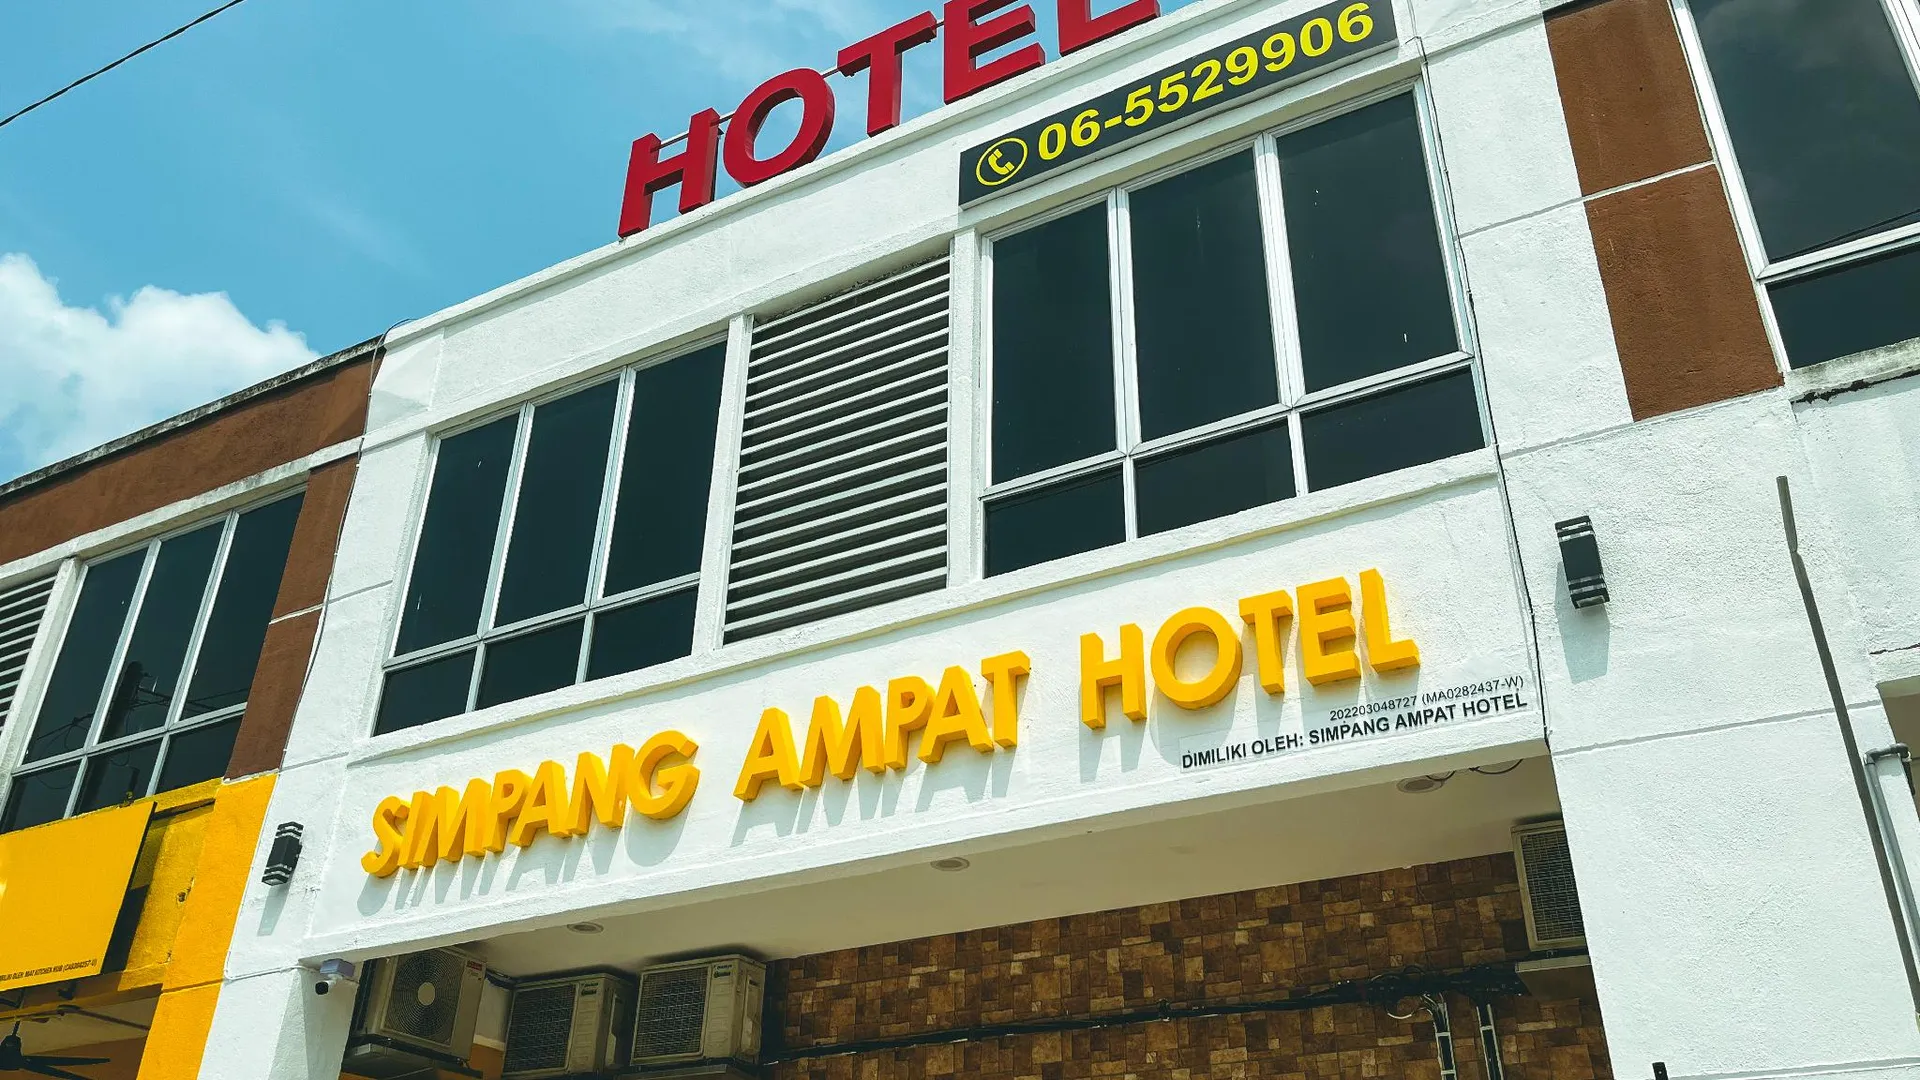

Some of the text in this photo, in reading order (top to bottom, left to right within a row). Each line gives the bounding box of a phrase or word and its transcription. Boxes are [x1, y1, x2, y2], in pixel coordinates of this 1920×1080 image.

[617, 0, 1160, 239] HOTEL
[1037, 2, 1374, 161] 06-5529906
[361, 568, 1420, 877] SIMPANG AMPAT HOTEL
[1182, 692, 1528, 769] DIMILIKI OLEH: SIMPANG AMPAT HOTEL
[1329, 675, 1524, 721] 202203048727 (MA0282437-W)
